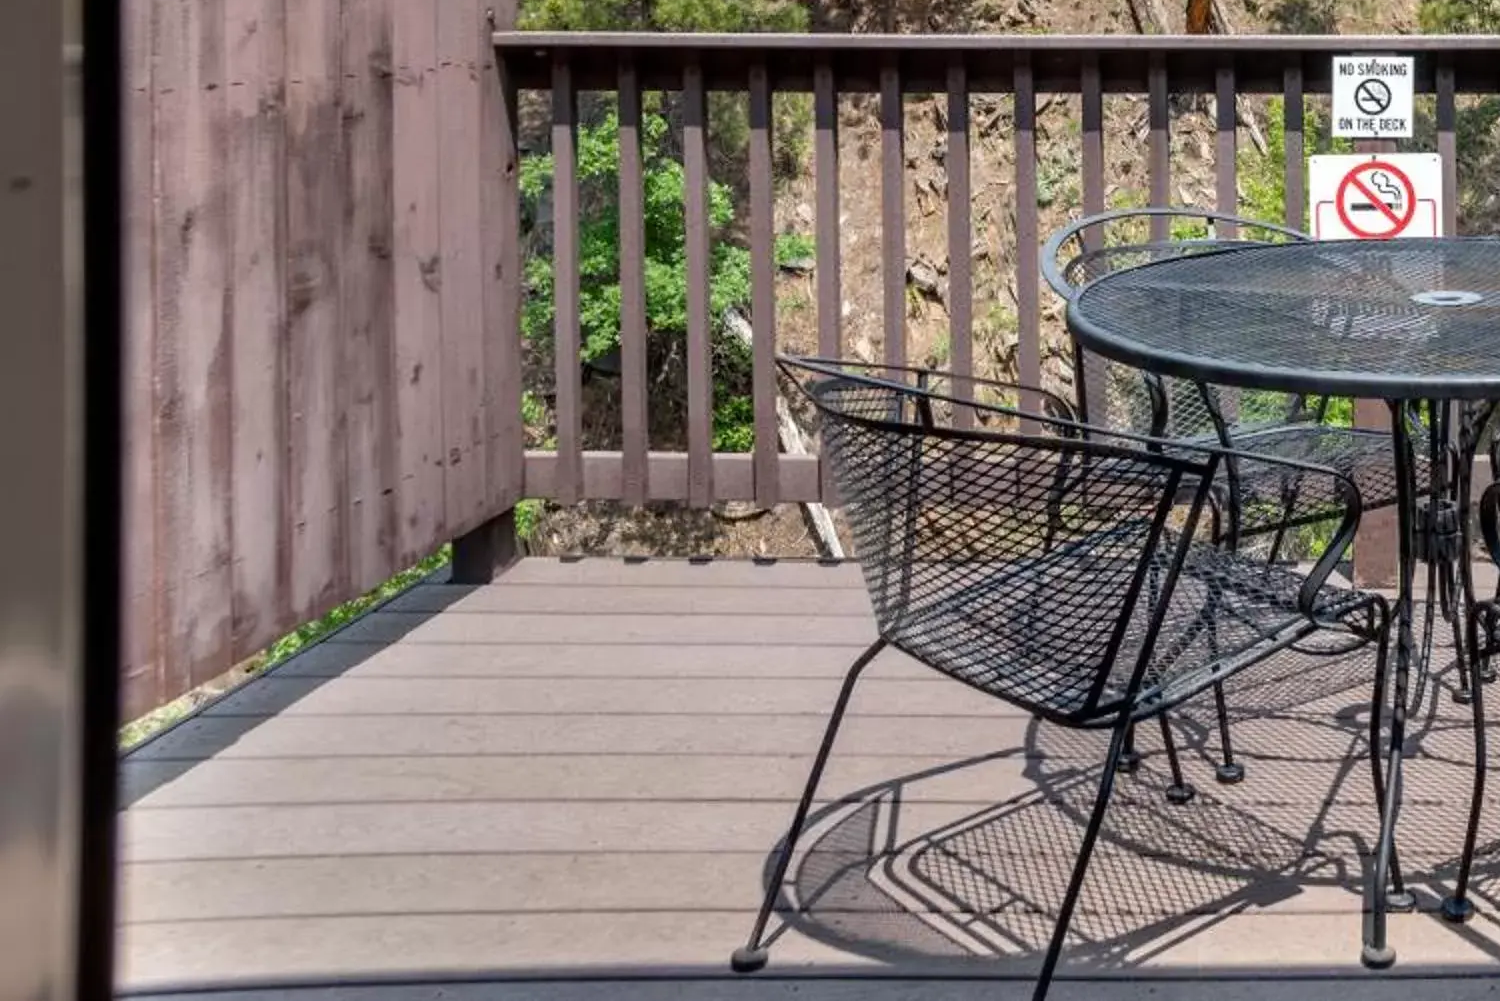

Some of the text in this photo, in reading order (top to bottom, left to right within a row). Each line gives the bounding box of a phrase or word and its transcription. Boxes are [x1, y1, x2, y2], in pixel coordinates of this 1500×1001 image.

[1339, 62, 1408, 77] NO SMOKING
[1338, 117, 1407, 132] ON THE DECK
